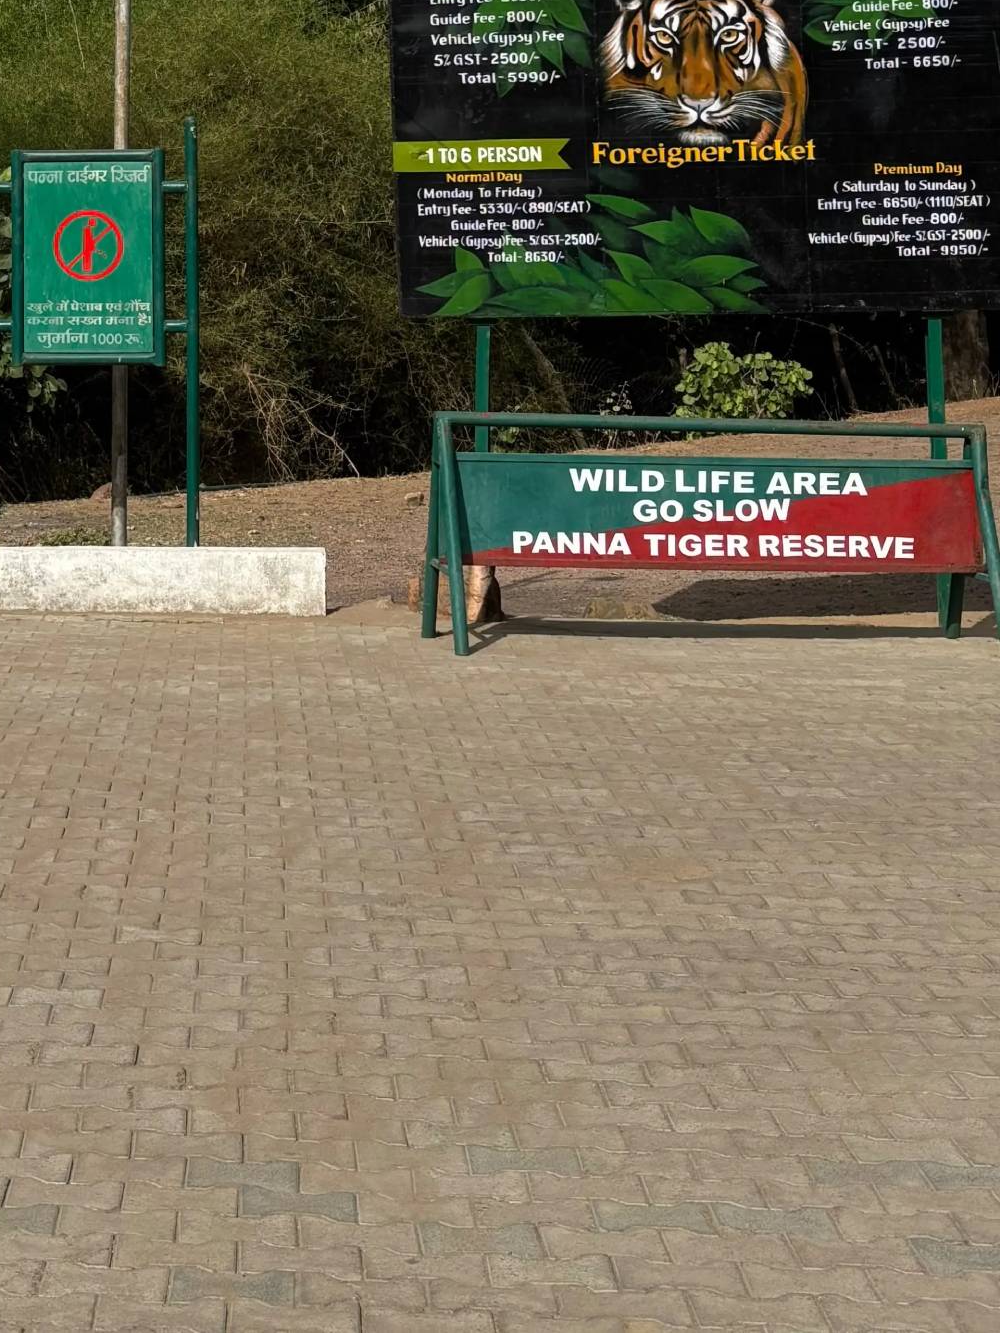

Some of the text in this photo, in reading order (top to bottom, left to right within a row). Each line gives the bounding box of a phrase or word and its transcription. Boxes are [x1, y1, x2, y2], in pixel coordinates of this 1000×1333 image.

[852, 1, 890, 13] Guide
[430, 13, 471, 26] Guide
[823, 20, 872, 33] Vehicle
[430, 33, 481, 46] Vehicle
[438, 148, 457, 163] TO
[460, 147, 472, 163] 6
[478, 146, 543, 163] PERSON
[592, 138, 816, 168] Foreigner Ticket
[874, 162, 963, 176] Premium Day
[28, 170, 64, 184] पन्ना
[445, 171, 523, 184] Normal Day
[478, 187, 491, 198] To
[904, 180, 917, 192] to
[417, 204, 450, 217] Entry
[817, 198, 852, 212] Entry
[451, 220, 486, 231] Guide
[862, 215, 900, 226] Guide
[418, 236, 460, 248] Vehicle
[808, 232, 849, 245] Vehicle
[70, 300, 103, 311] पेशाब
[25, 316, 64, 325] करना
[105, 316, 135, 325] मना
[37, 328, 89, 348] जुर्माना
[91, 333, 123, 345] 1000
[569, 468, 868, 497] WILD LIFE AREA
[632, 497, 791, 523] GO SLOW
[512, 530, 915, 560] PANNA TIGER RESERVE
